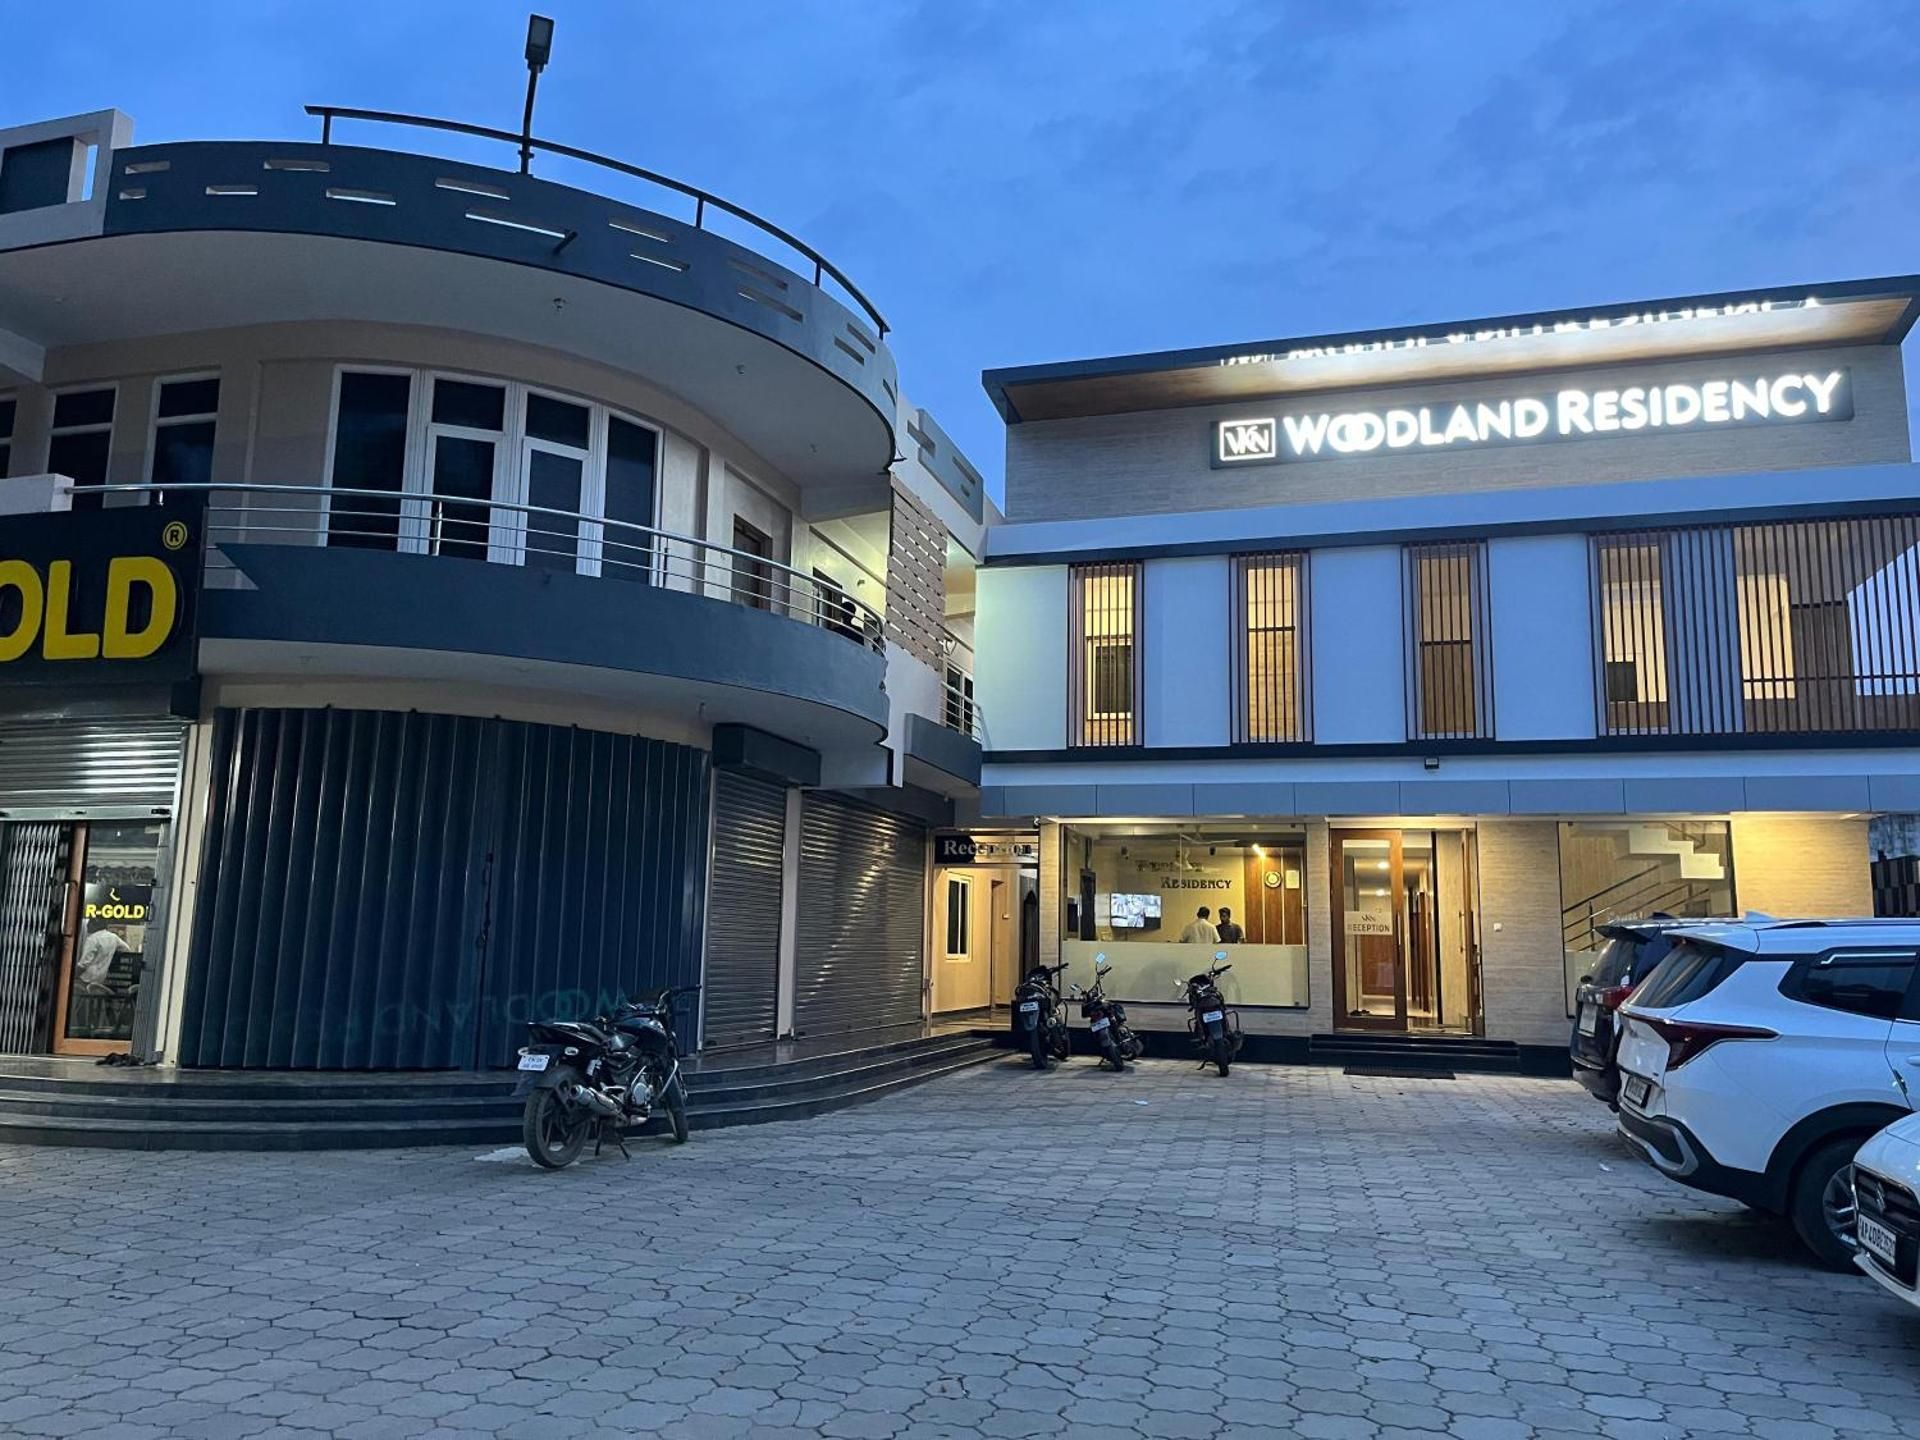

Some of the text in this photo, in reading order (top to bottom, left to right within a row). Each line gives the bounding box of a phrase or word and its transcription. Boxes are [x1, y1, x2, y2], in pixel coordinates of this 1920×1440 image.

[1283, 371, 1842, 455] WOODLAND RESIDENCY
[85, 904, 145, 919] R-GOLD
[1347, 923, 1390, 932] ECEPTION
